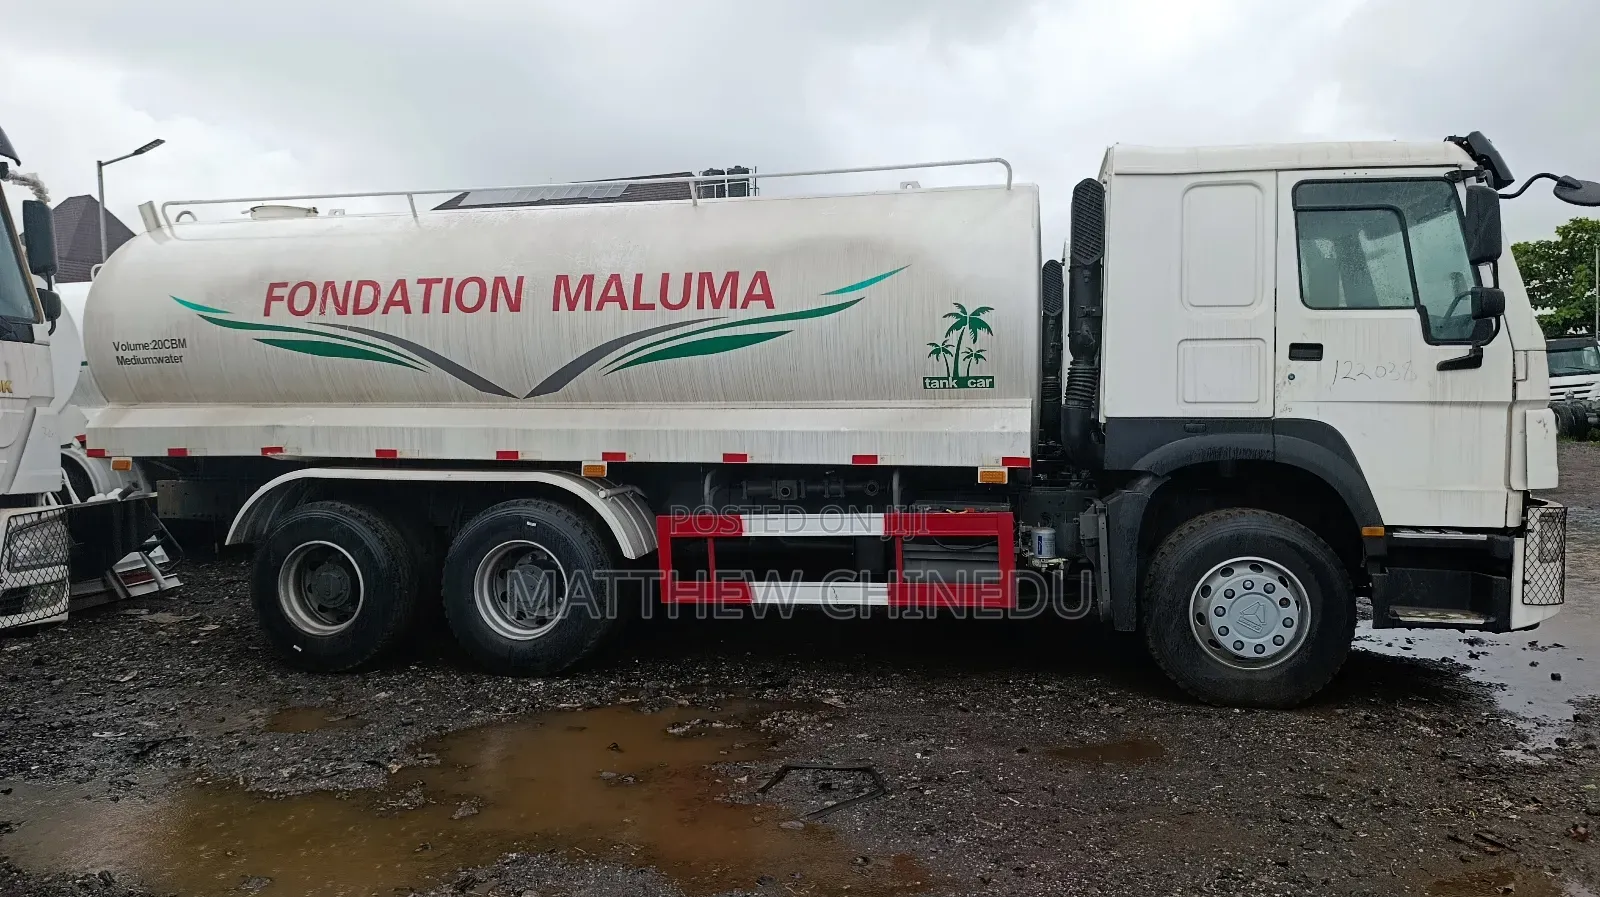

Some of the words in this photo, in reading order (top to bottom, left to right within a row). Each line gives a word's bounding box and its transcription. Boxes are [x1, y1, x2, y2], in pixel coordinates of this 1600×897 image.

[263, 275, 525, 317] FONDATION
[552, 270, 775, 312] MALUMA
[924, 377, 958, 388] tank
[967, 378, 992, 388] car
